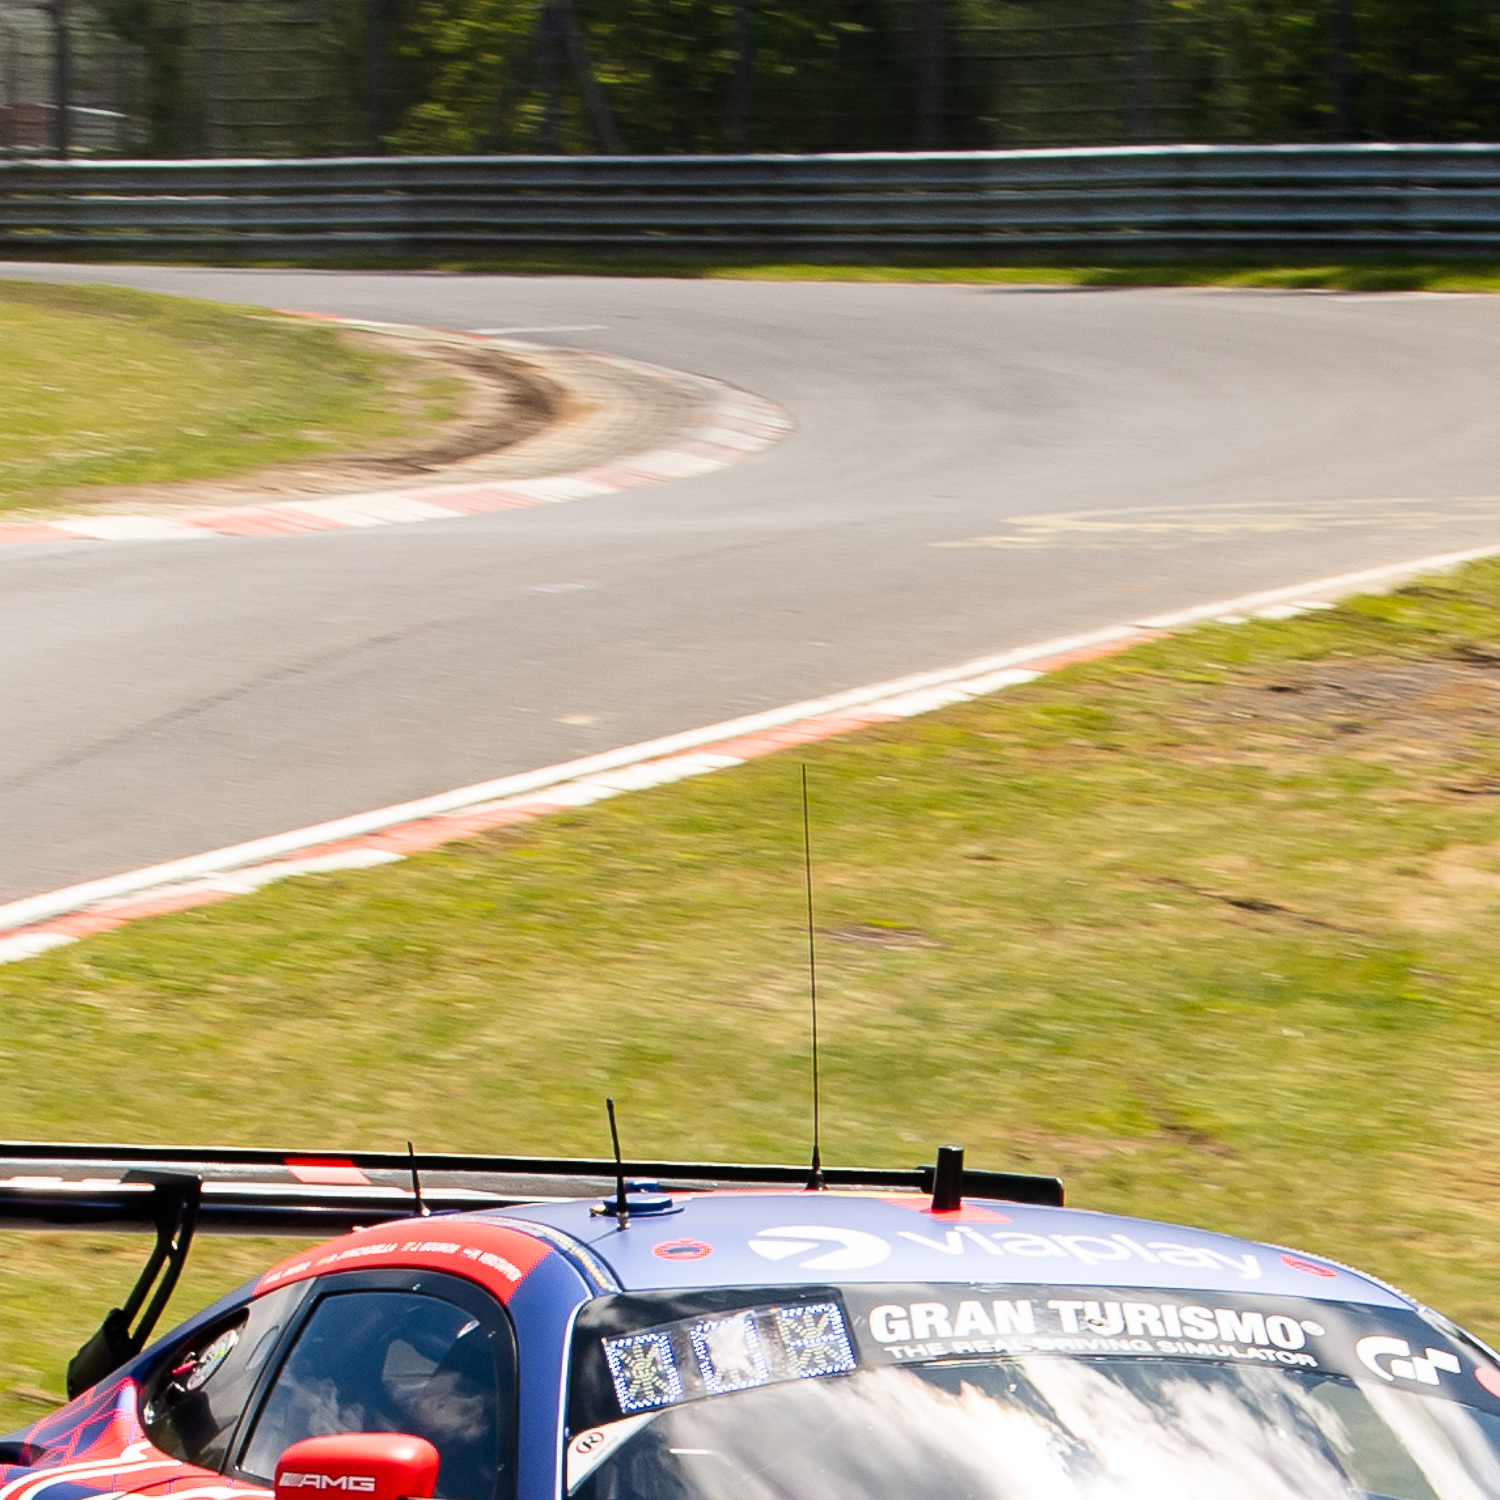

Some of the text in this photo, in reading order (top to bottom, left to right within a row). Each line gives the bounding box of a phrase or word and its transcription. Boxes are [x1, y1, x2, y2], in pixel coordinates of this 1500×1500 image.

[896, 1225, 1263, 1280] viaplay
[868, 1300, 1036, 1343] GRAN
[883, 1341, 948, 1360] THE
[1156, 1339, 1318, 1368] SIMULATOR
[298, 1473, 376, 1492] AMG
